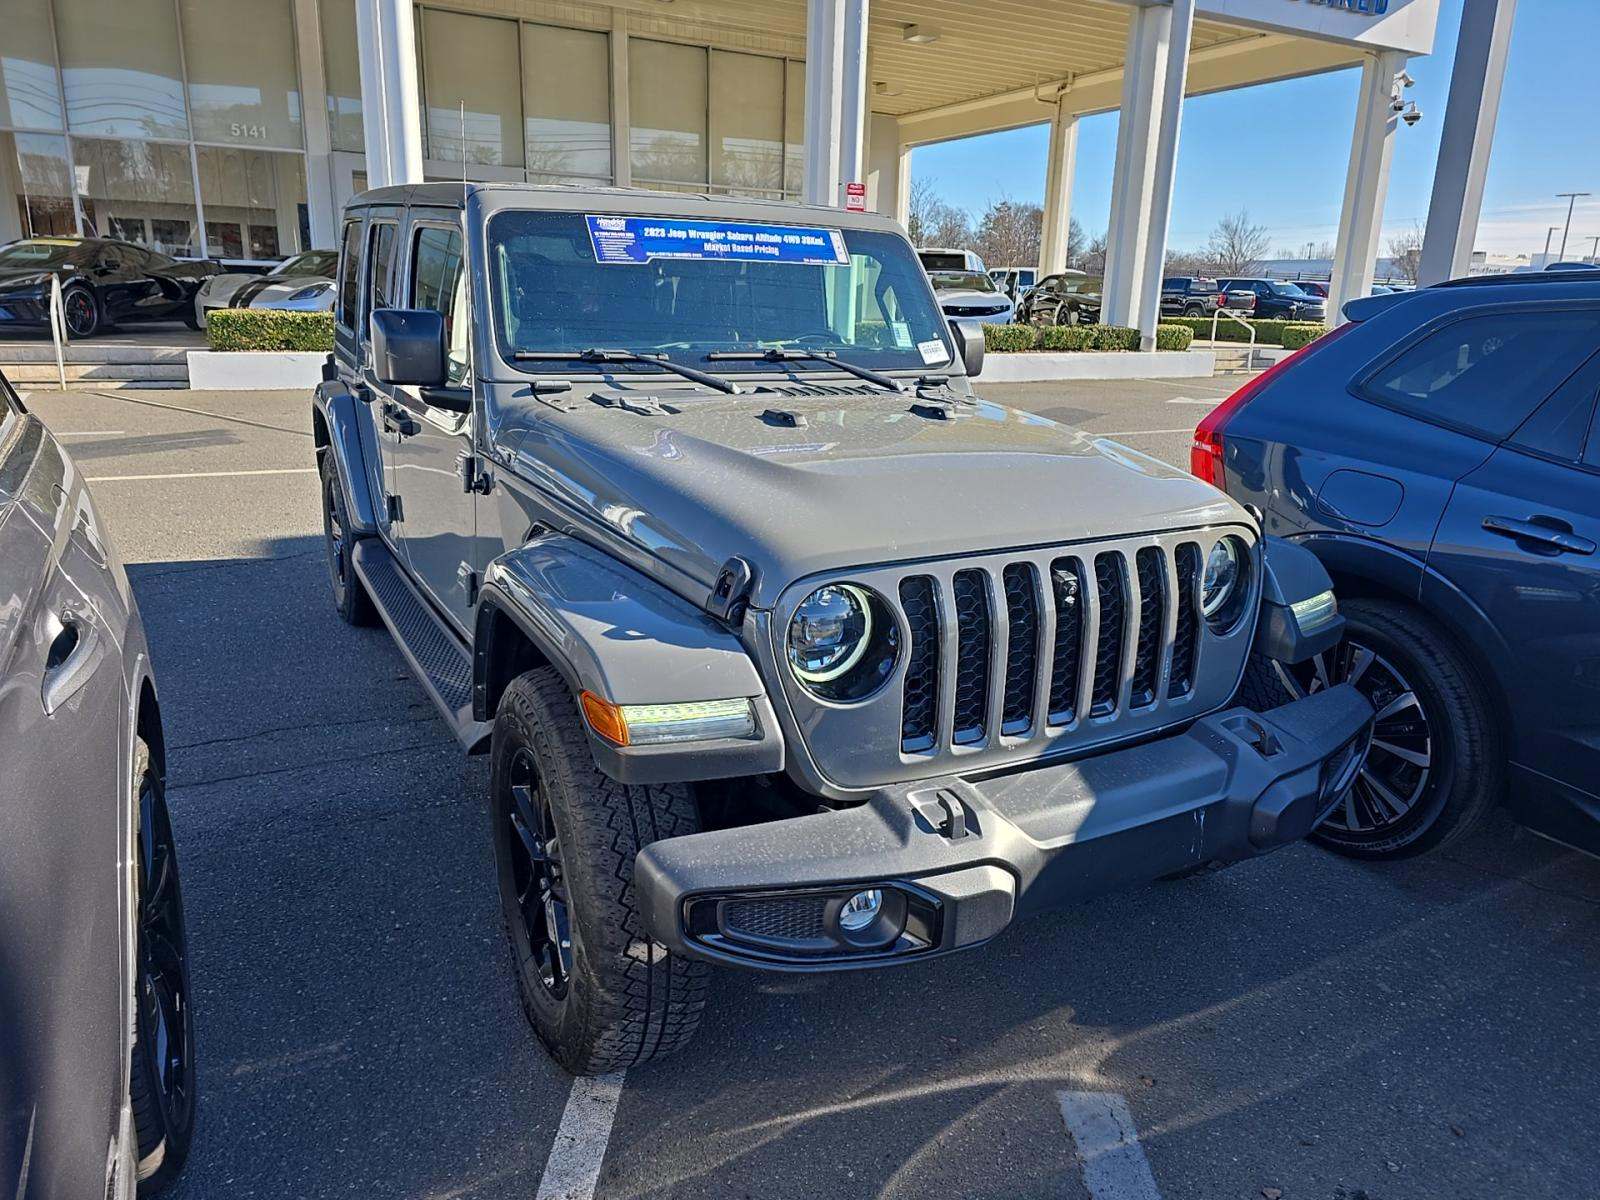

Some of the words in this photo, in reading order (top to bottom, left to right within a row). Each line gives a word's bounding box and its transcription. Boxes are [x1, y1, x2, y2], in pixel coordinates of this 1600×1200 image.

[231, 123, 266, 139] 5141
[667, 228, 687, 240] Jeep
[688, 229, 726, 241] Wrangler
[726, 231, 754, 242] Sahara
[703, 242, 731, 252] Market
[731, 243, 753, 254] Based
[754, 245, 779, 256] Pricing
